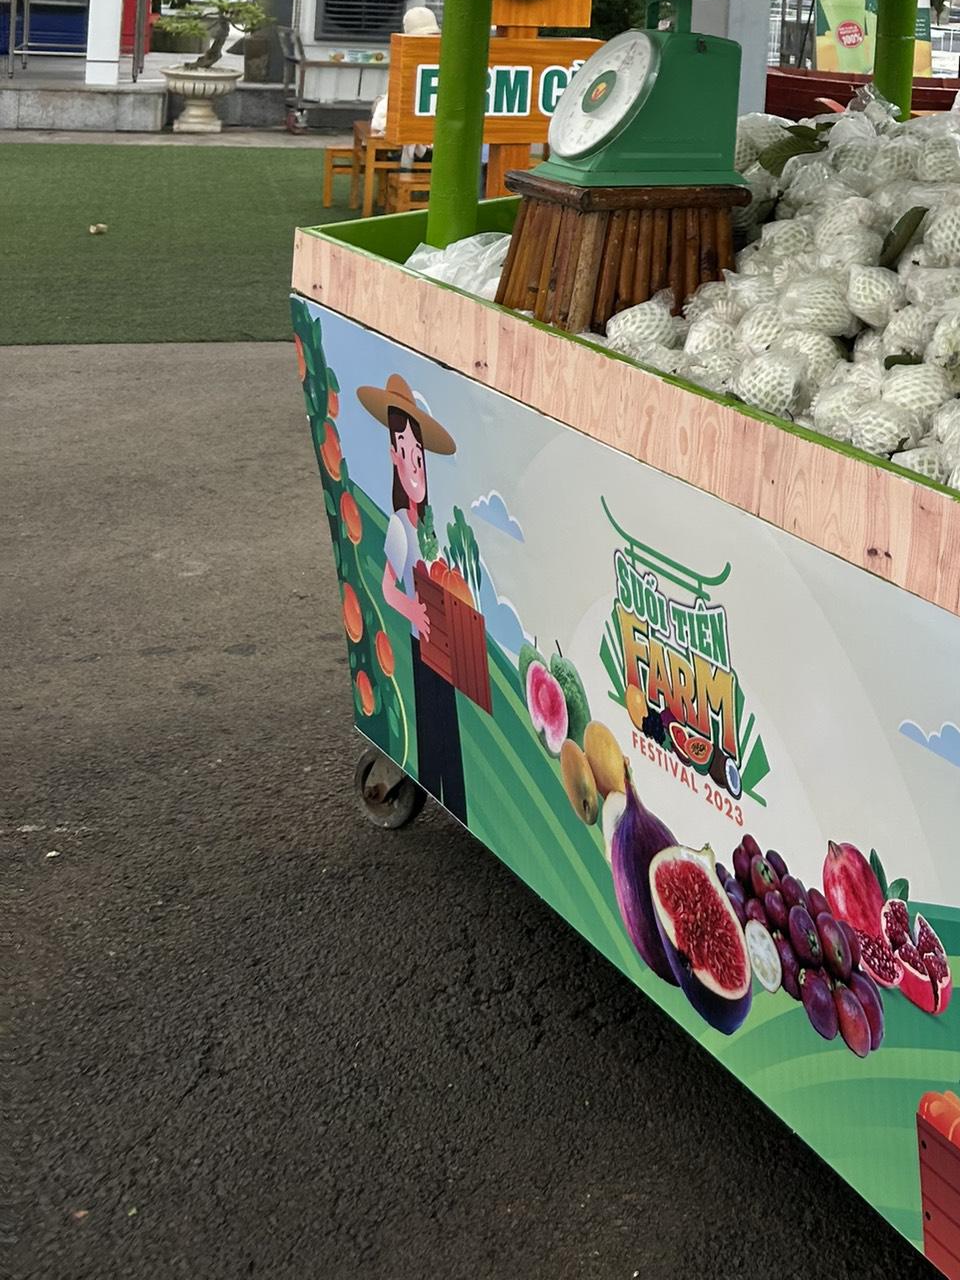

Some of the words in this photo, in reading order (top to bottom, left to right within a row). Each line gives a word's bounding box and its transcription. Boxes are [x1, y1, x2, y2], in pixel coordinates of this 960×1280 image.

[417, 66, 531, 115] FM
[616, 551, 669, 636] SUỐI
[671, 599, 730, 671] TIÊN
[619, 606, 738, 761] FARM
[631, 730, 699, 794] FESTIVAL
[703, 783, 744, 827] 2023
